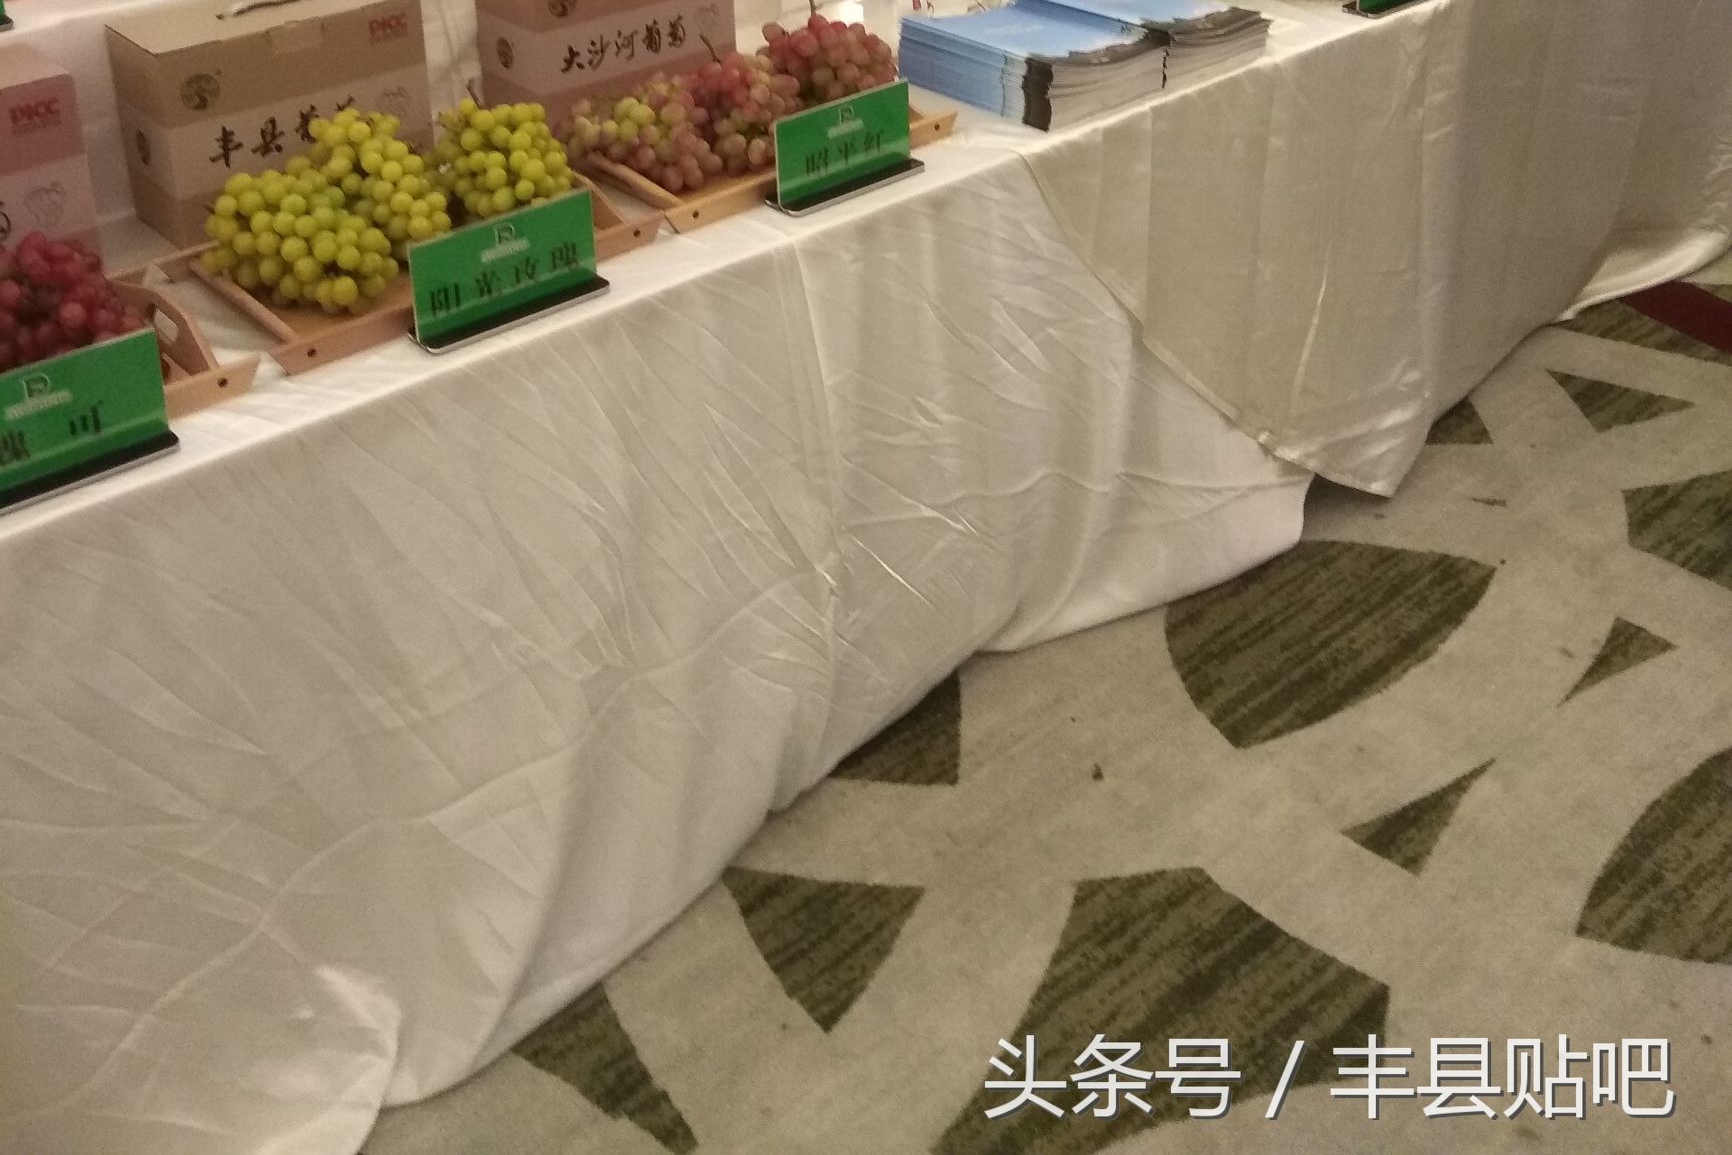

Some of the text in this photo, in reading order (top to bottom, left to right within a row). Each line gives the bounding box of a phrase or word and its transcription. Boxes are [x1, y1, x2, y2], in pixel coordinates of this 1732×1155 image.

[560, 13, 687, 74] 大沙河葡萄
